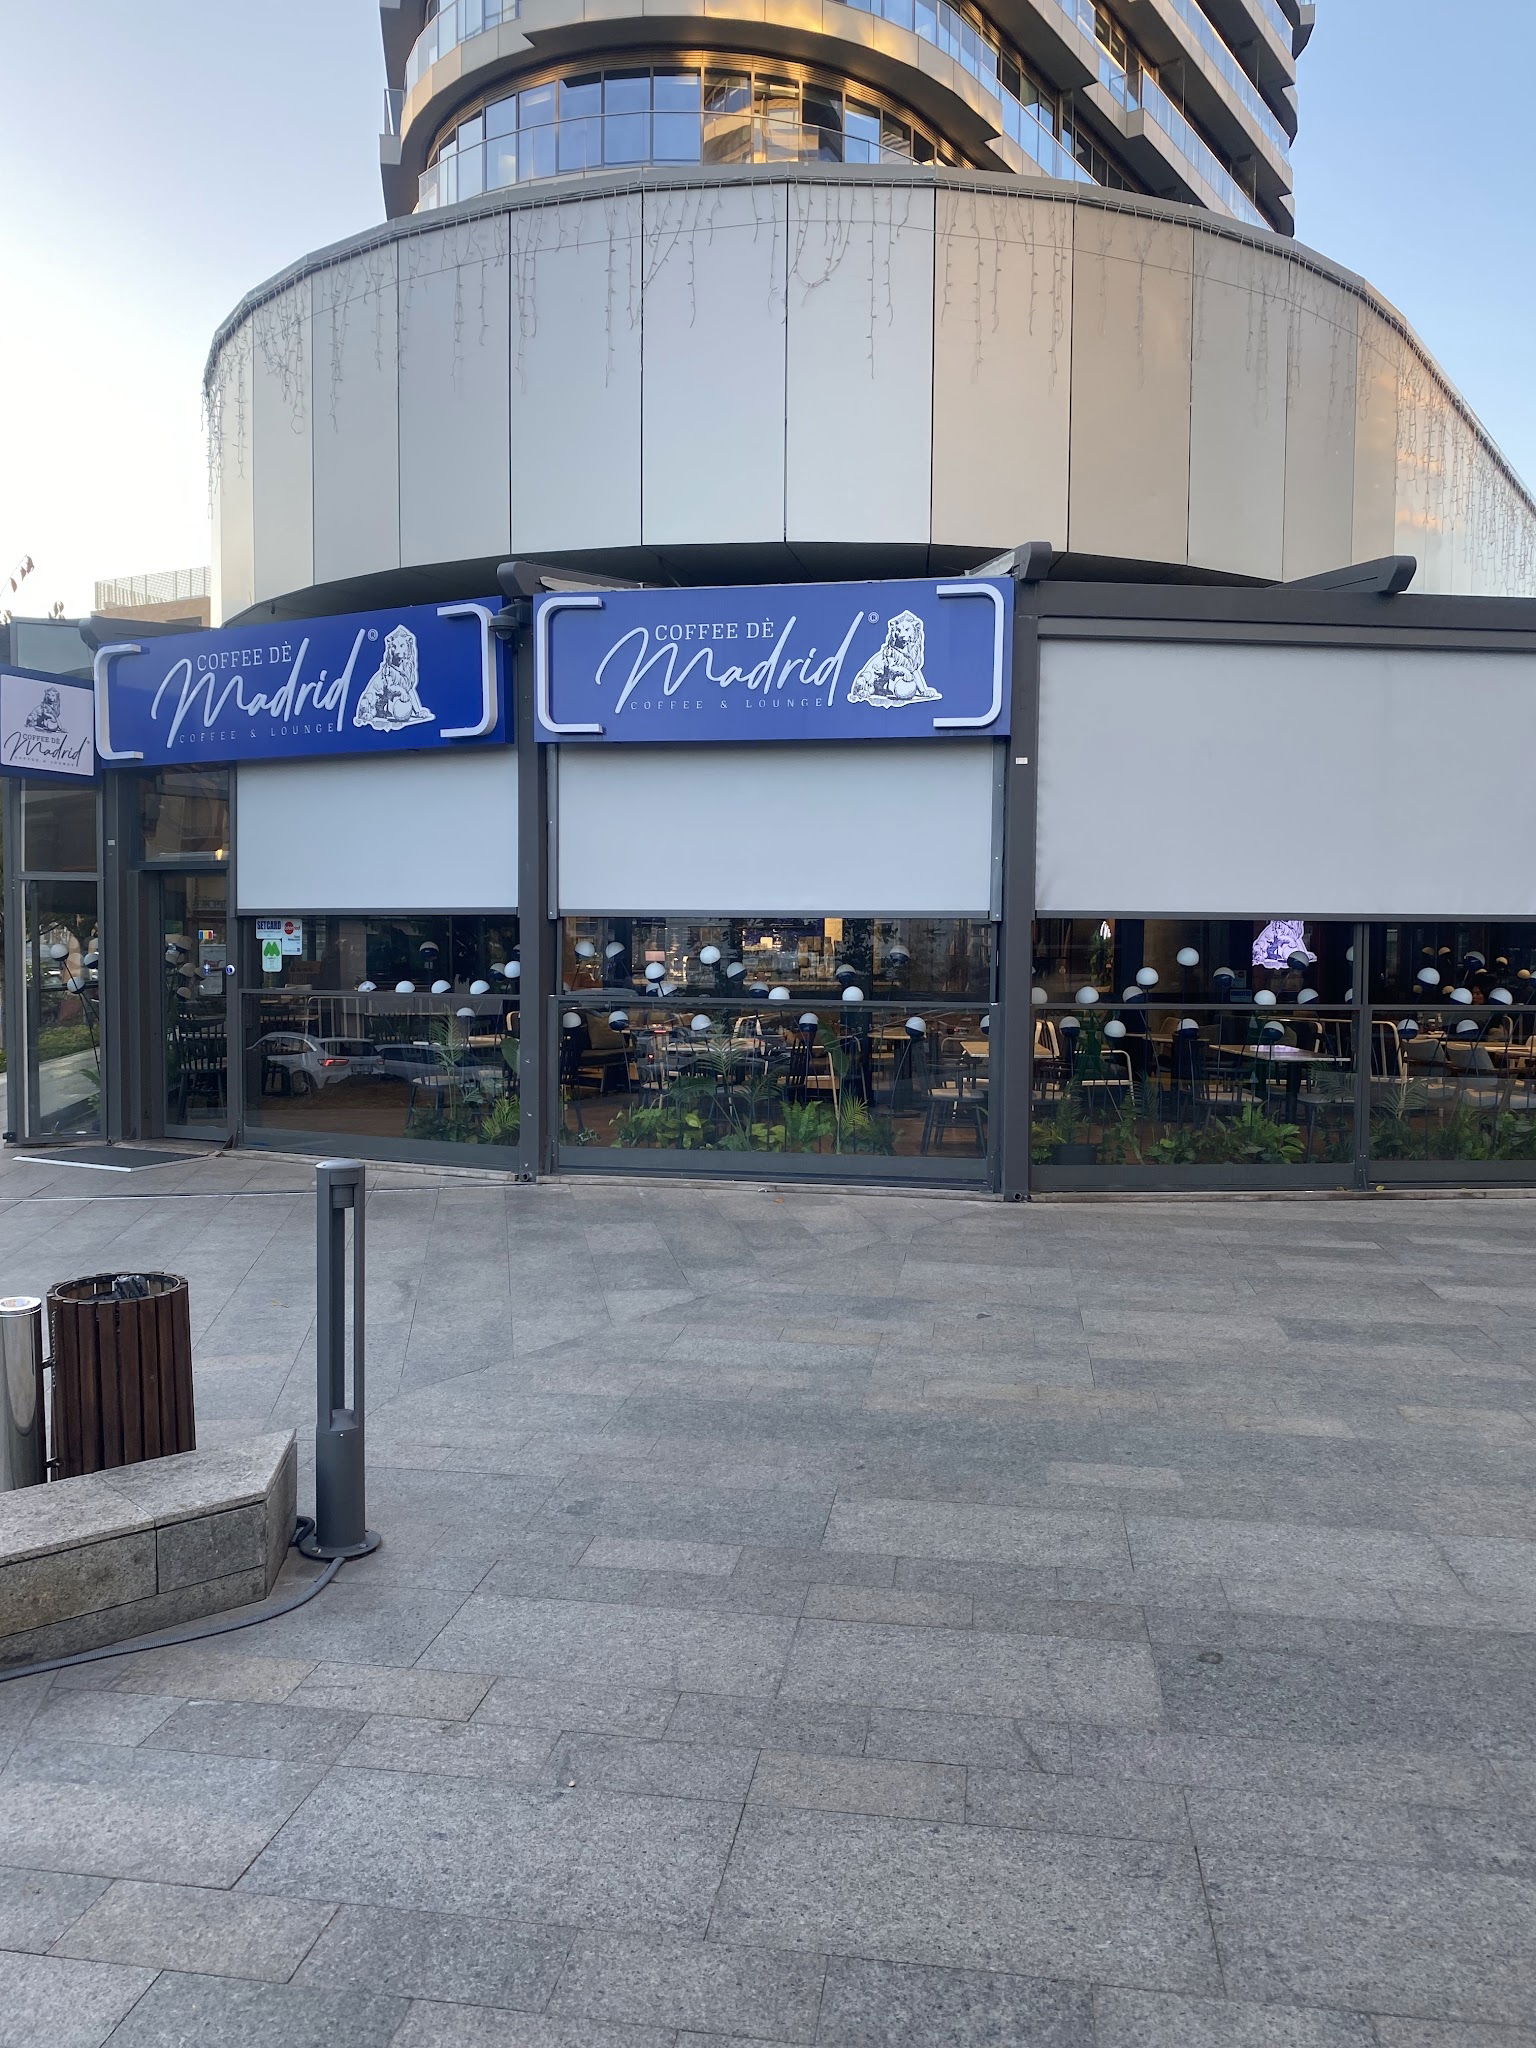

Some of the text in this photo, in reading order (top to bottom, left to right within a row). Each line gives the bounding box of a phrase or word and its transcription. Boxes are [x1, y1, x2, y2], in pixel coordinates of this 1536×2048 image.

[655, 617, 774, 641] COFFEE DÈ
[197, 640, 292, 672] COFFEE DÈ
[595, 611, 865, 714] Madrid
[151, 628, 366, 749] Madrid
[630, 697, 822, 710] COFFEE & LOUNGE
[22, 733, 50, 743] COFFEE
[179, 722, 333, 744] COFFEE & LOUNGE
[4, 731, 88, 768] Madrid
[257, 920, 281, 930] SETCARD
